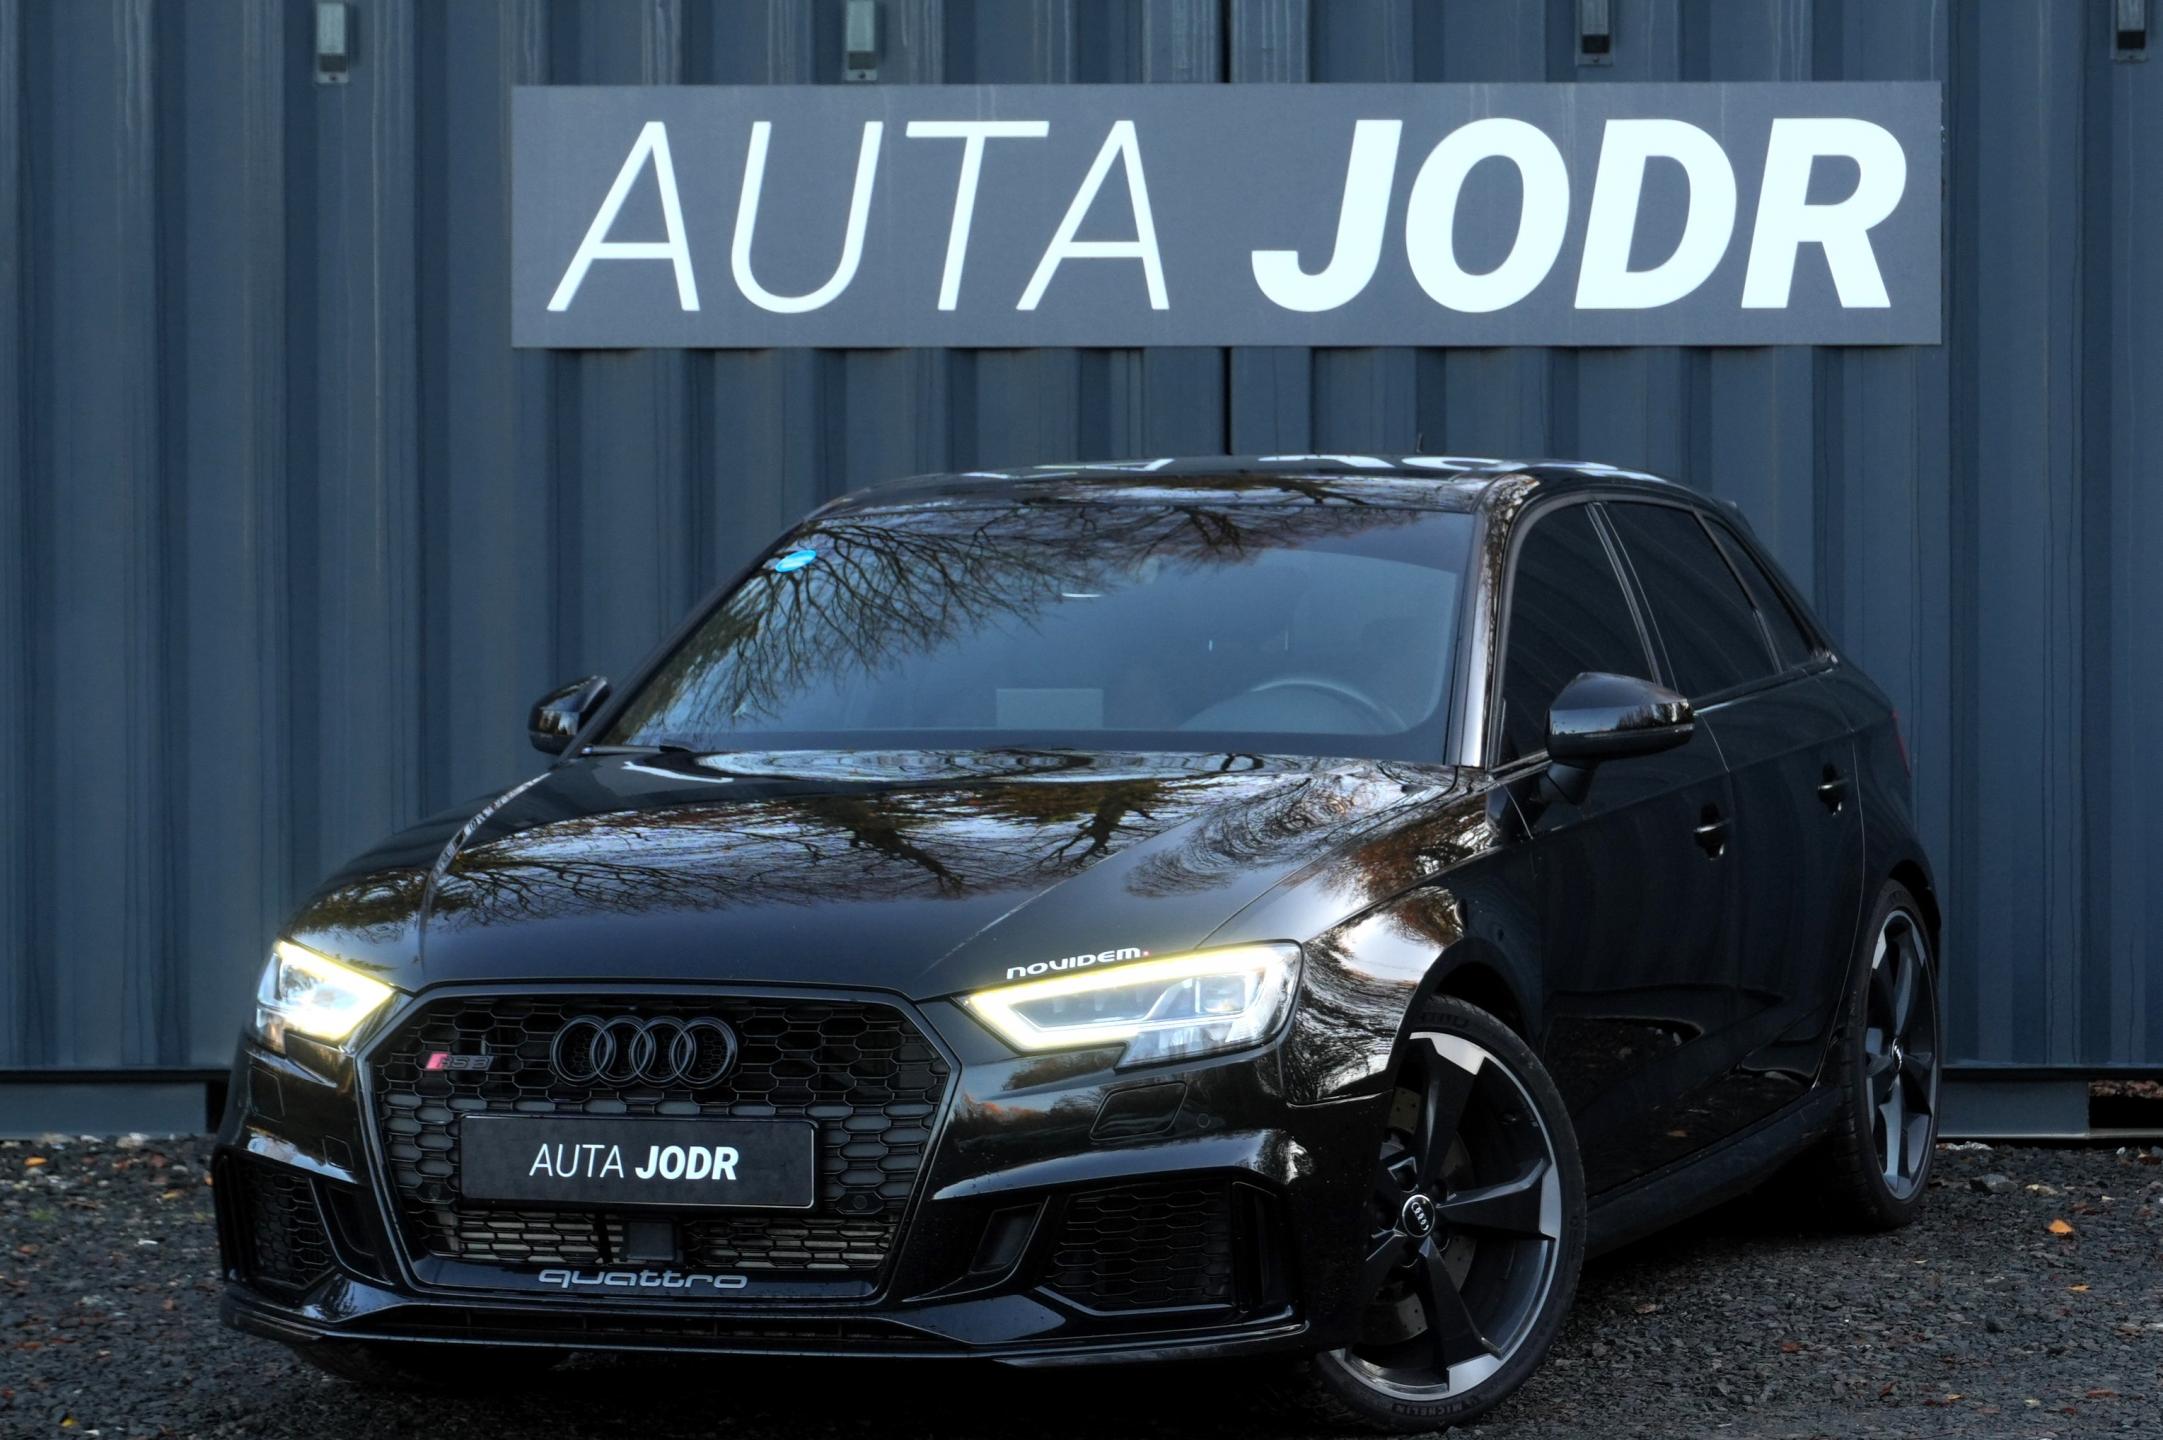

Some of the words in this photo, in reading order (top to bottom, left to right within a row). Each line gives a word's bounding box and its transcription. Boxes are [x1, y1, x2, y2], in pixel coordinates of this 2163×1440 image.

[547, 120, 1169, 315] AUTA
[1250, 117, 1908, 313] JODR
[529, 1144, 624, 1178] AUTA
[635, 1145, 739, 1180] JODR
[538, 1269, 748, 1290] quattro
[1394, 1402, 1463, 1417] MICHELIN
